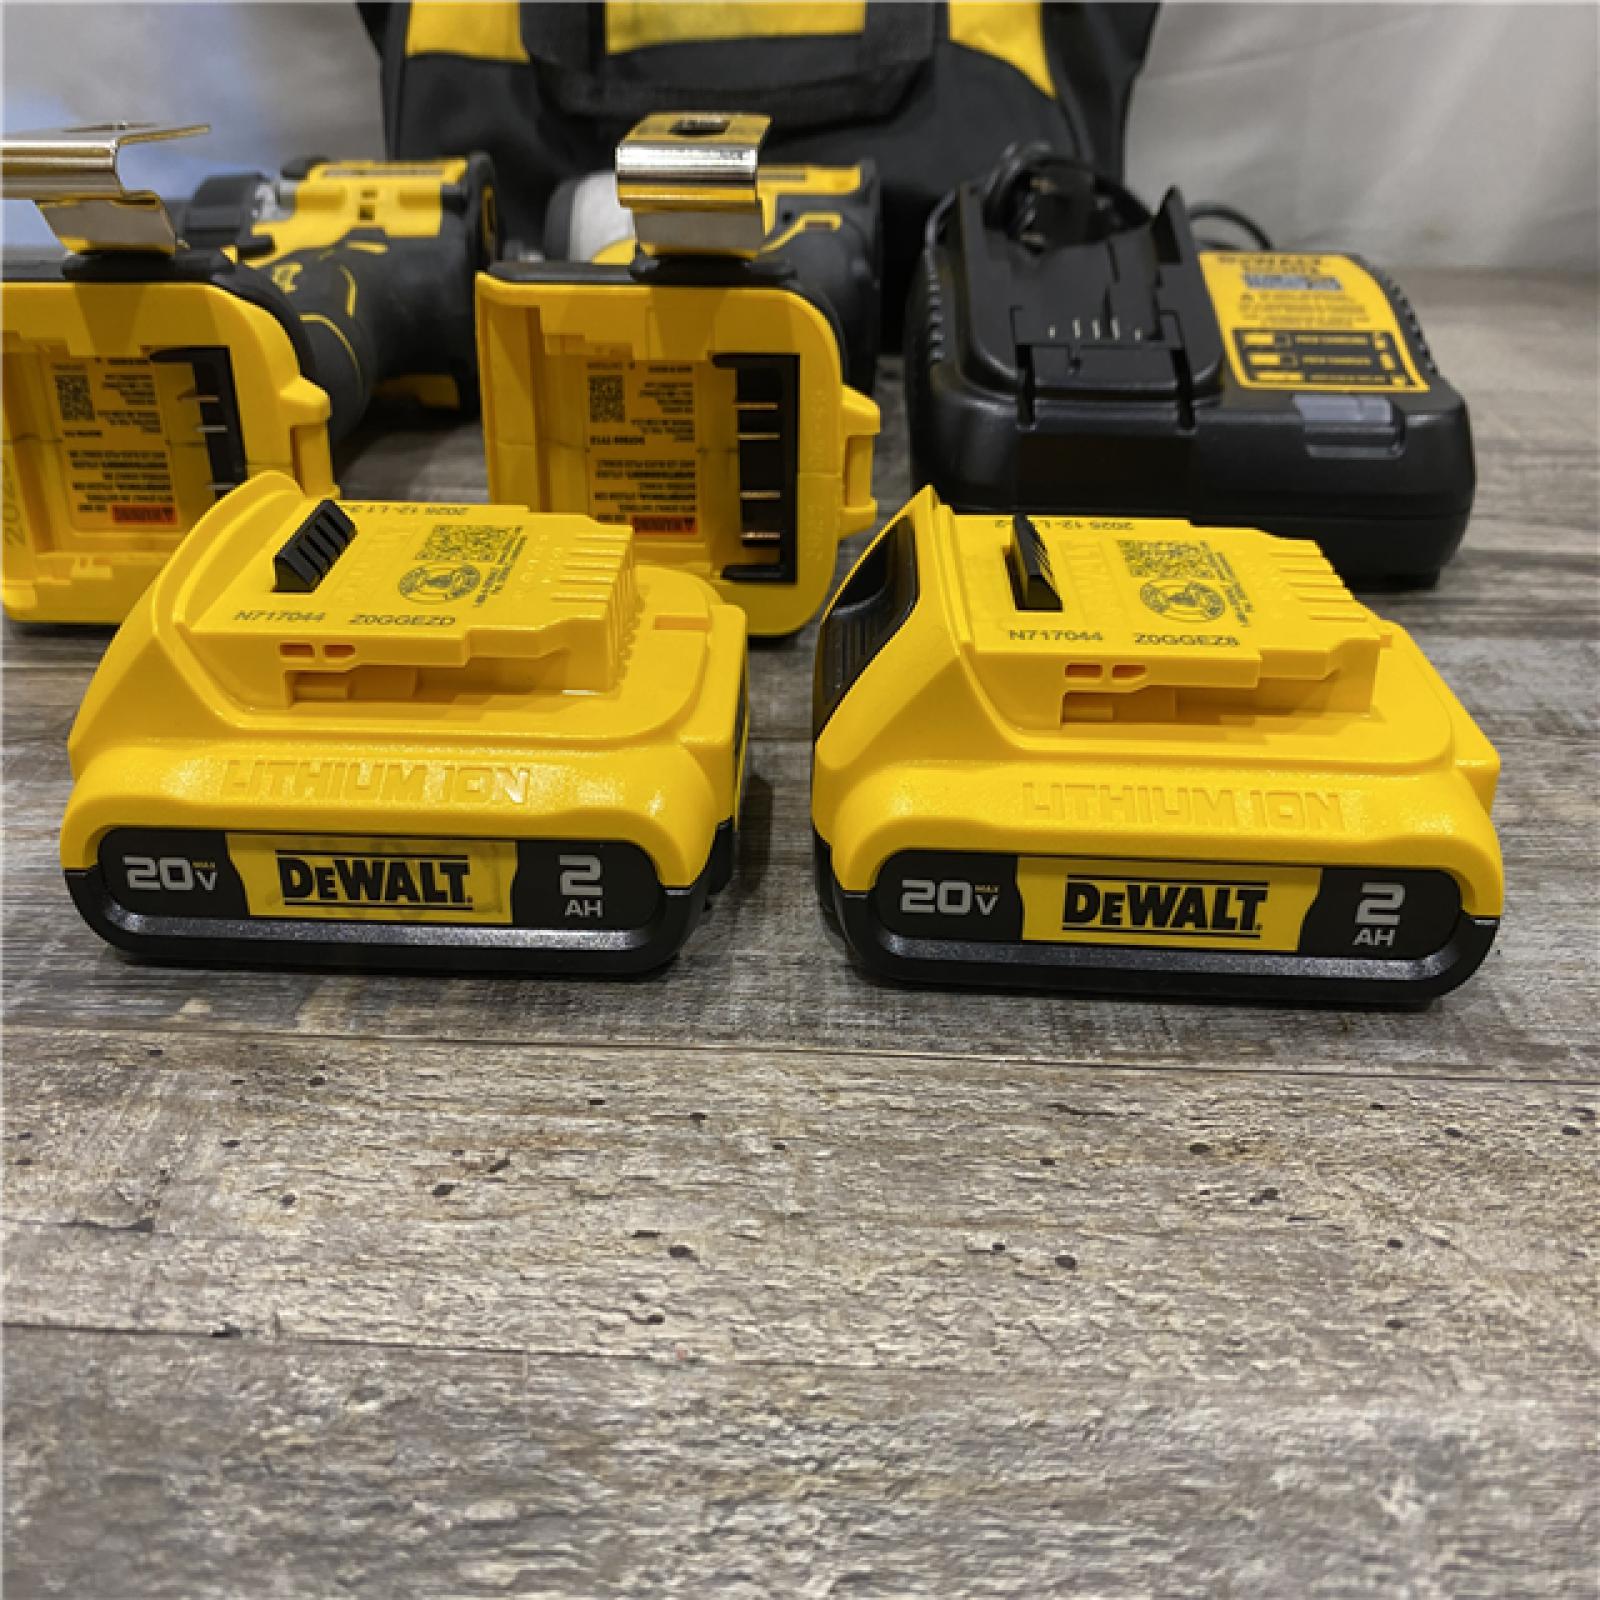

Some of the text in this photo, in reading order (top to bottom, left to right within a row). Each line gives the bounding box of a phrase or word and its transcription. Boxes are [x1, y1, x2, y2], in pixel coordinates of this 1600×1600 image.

[233, 609, 326, 622] N717044
[1009, 628, 1104, 642] N717044
[221, 758, 531, 804] LITHIUM ION
[1022, 781, 1345, 831] LITHIUM ION
[559, 854, 603, 896] 2
[565, 898, 603, 919] AH
[1355, 882, 1406, 926] 2
[1352, 928, 1395, 948] AH
